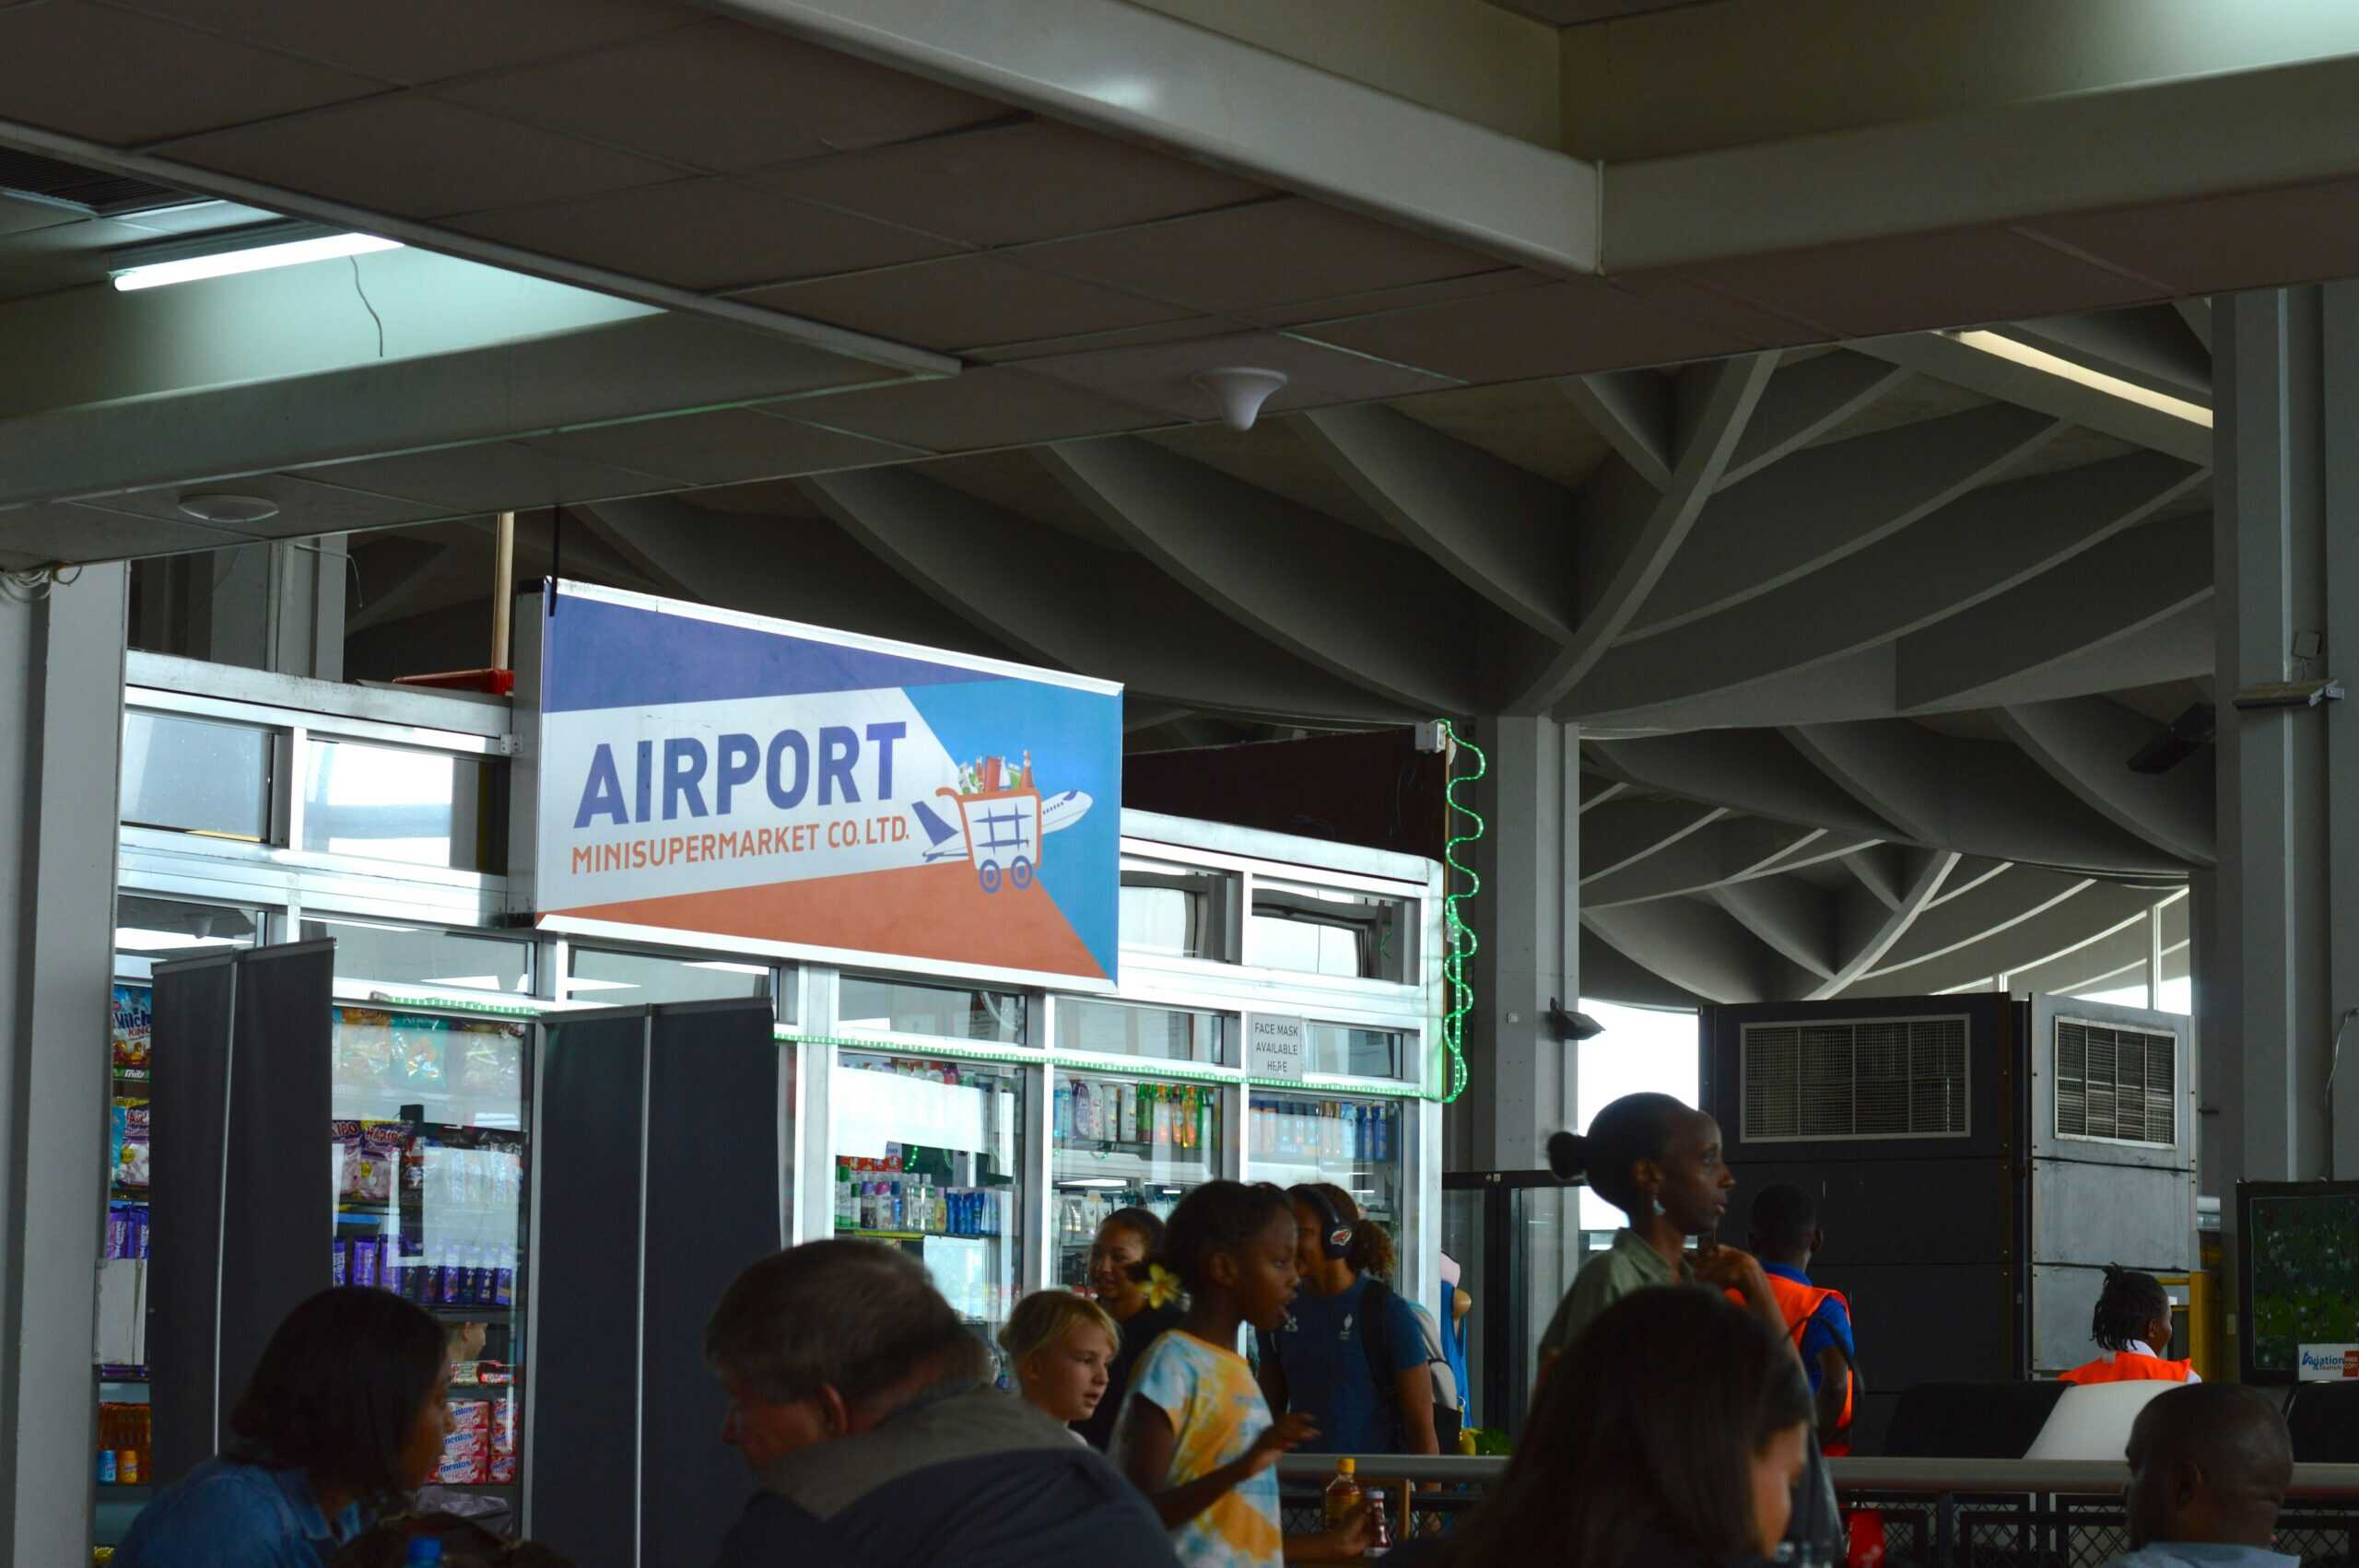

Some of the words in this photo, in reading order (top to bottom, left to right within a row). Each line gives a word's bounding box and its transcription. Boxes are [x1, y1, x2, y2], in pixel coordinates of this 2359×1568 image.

[573, 722, 907, 828] AIRPORT
[571, 823, 822, 874] MINISUPERMARKET
[827, 819, 862, 849] CO.
[866, 815, 910, 845] LTD.
[1254, 1022, 1276, 1036] FACE
[1277, 1024, 1298, 1037] MASK
[1256, 1041, 1298, 1056] AVAILABLE
[1267, 1059, 1288, 1073] HERE
